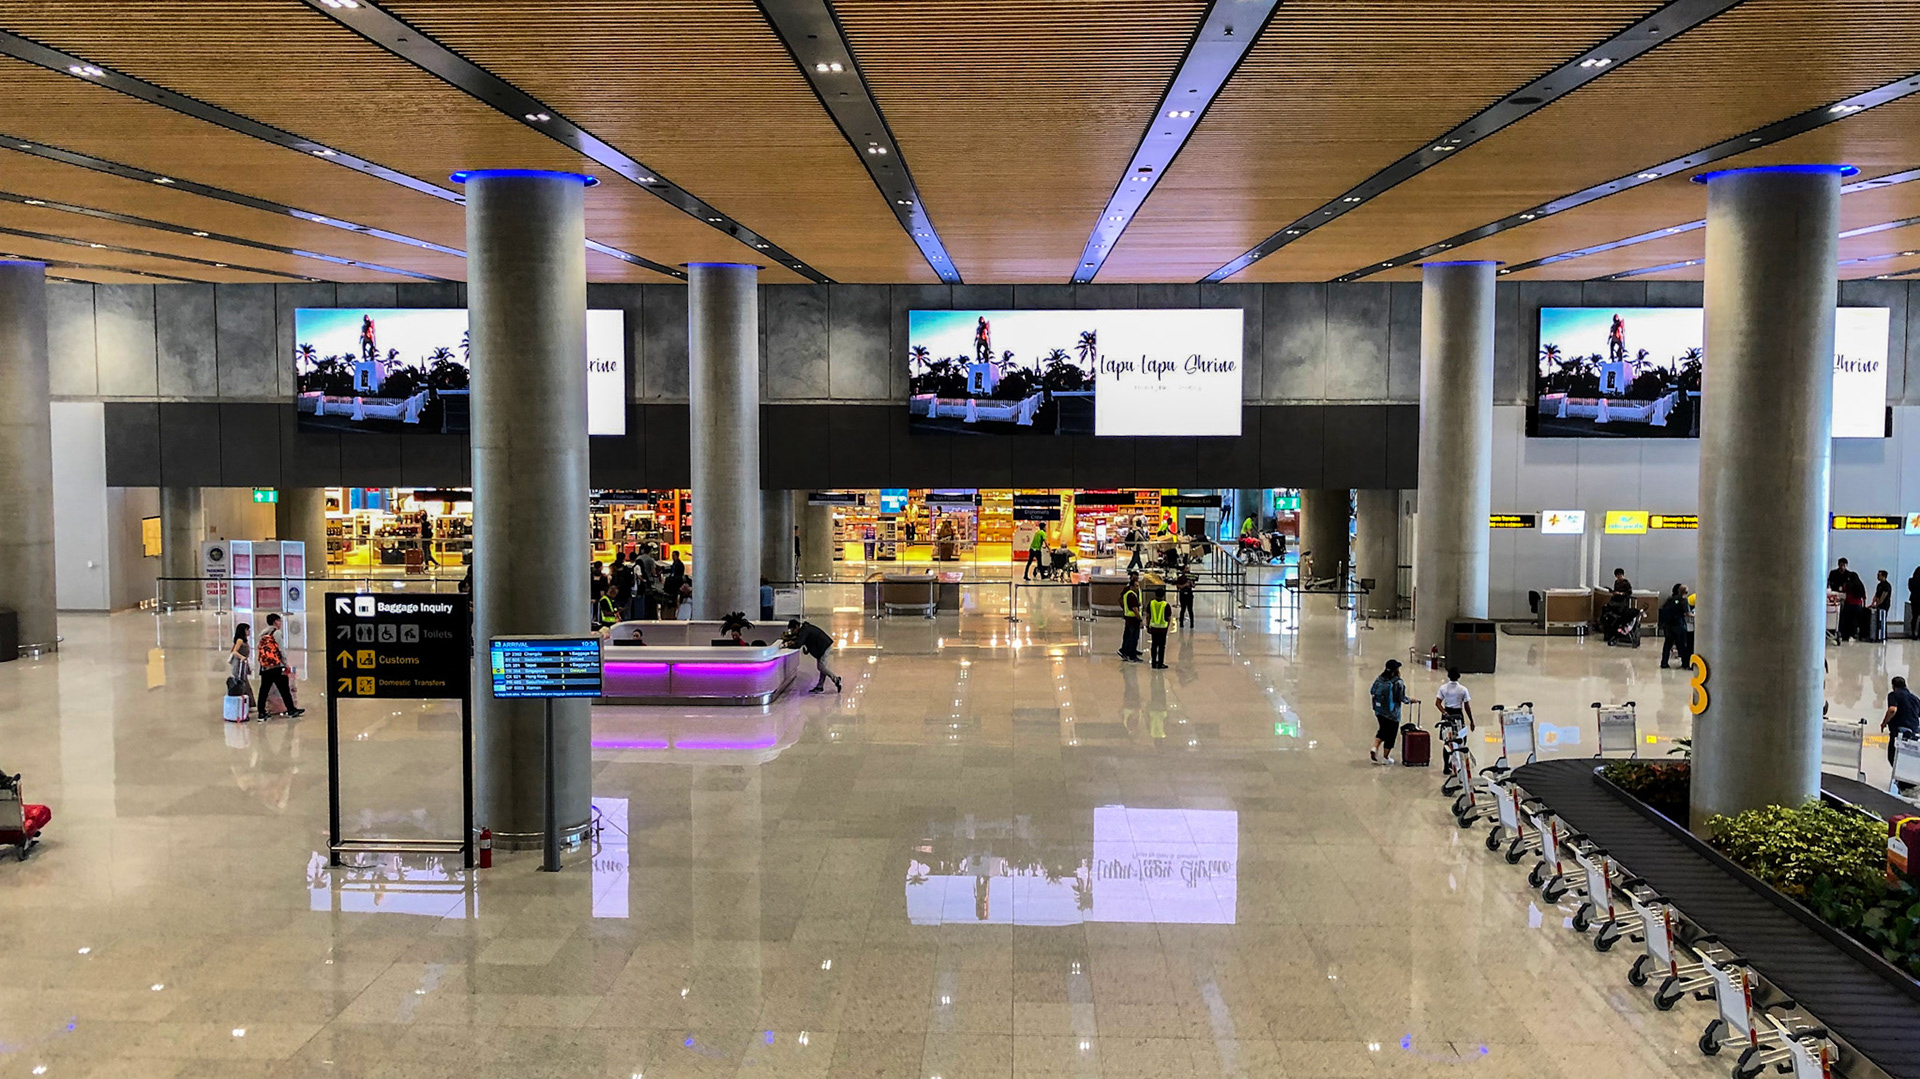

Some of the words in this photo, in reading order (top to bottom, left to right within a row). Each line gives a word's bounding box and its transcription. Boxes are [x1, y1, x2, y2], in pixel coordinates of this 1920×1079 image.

[589, 358, 617, 373] rine
[1184, 353, 1236, 375] Shrine
[378, 602, 419, 614] Baggage
[420, 602, 453, 614] Inquiry
[423, 628, 453, 639] Toilets
[378, 655, 419, 665] Customs
[378, 678, 411, 687] Domestic
[413, 678, 446, 687] Transfers
[1689, 654, 1708, 715] 3
